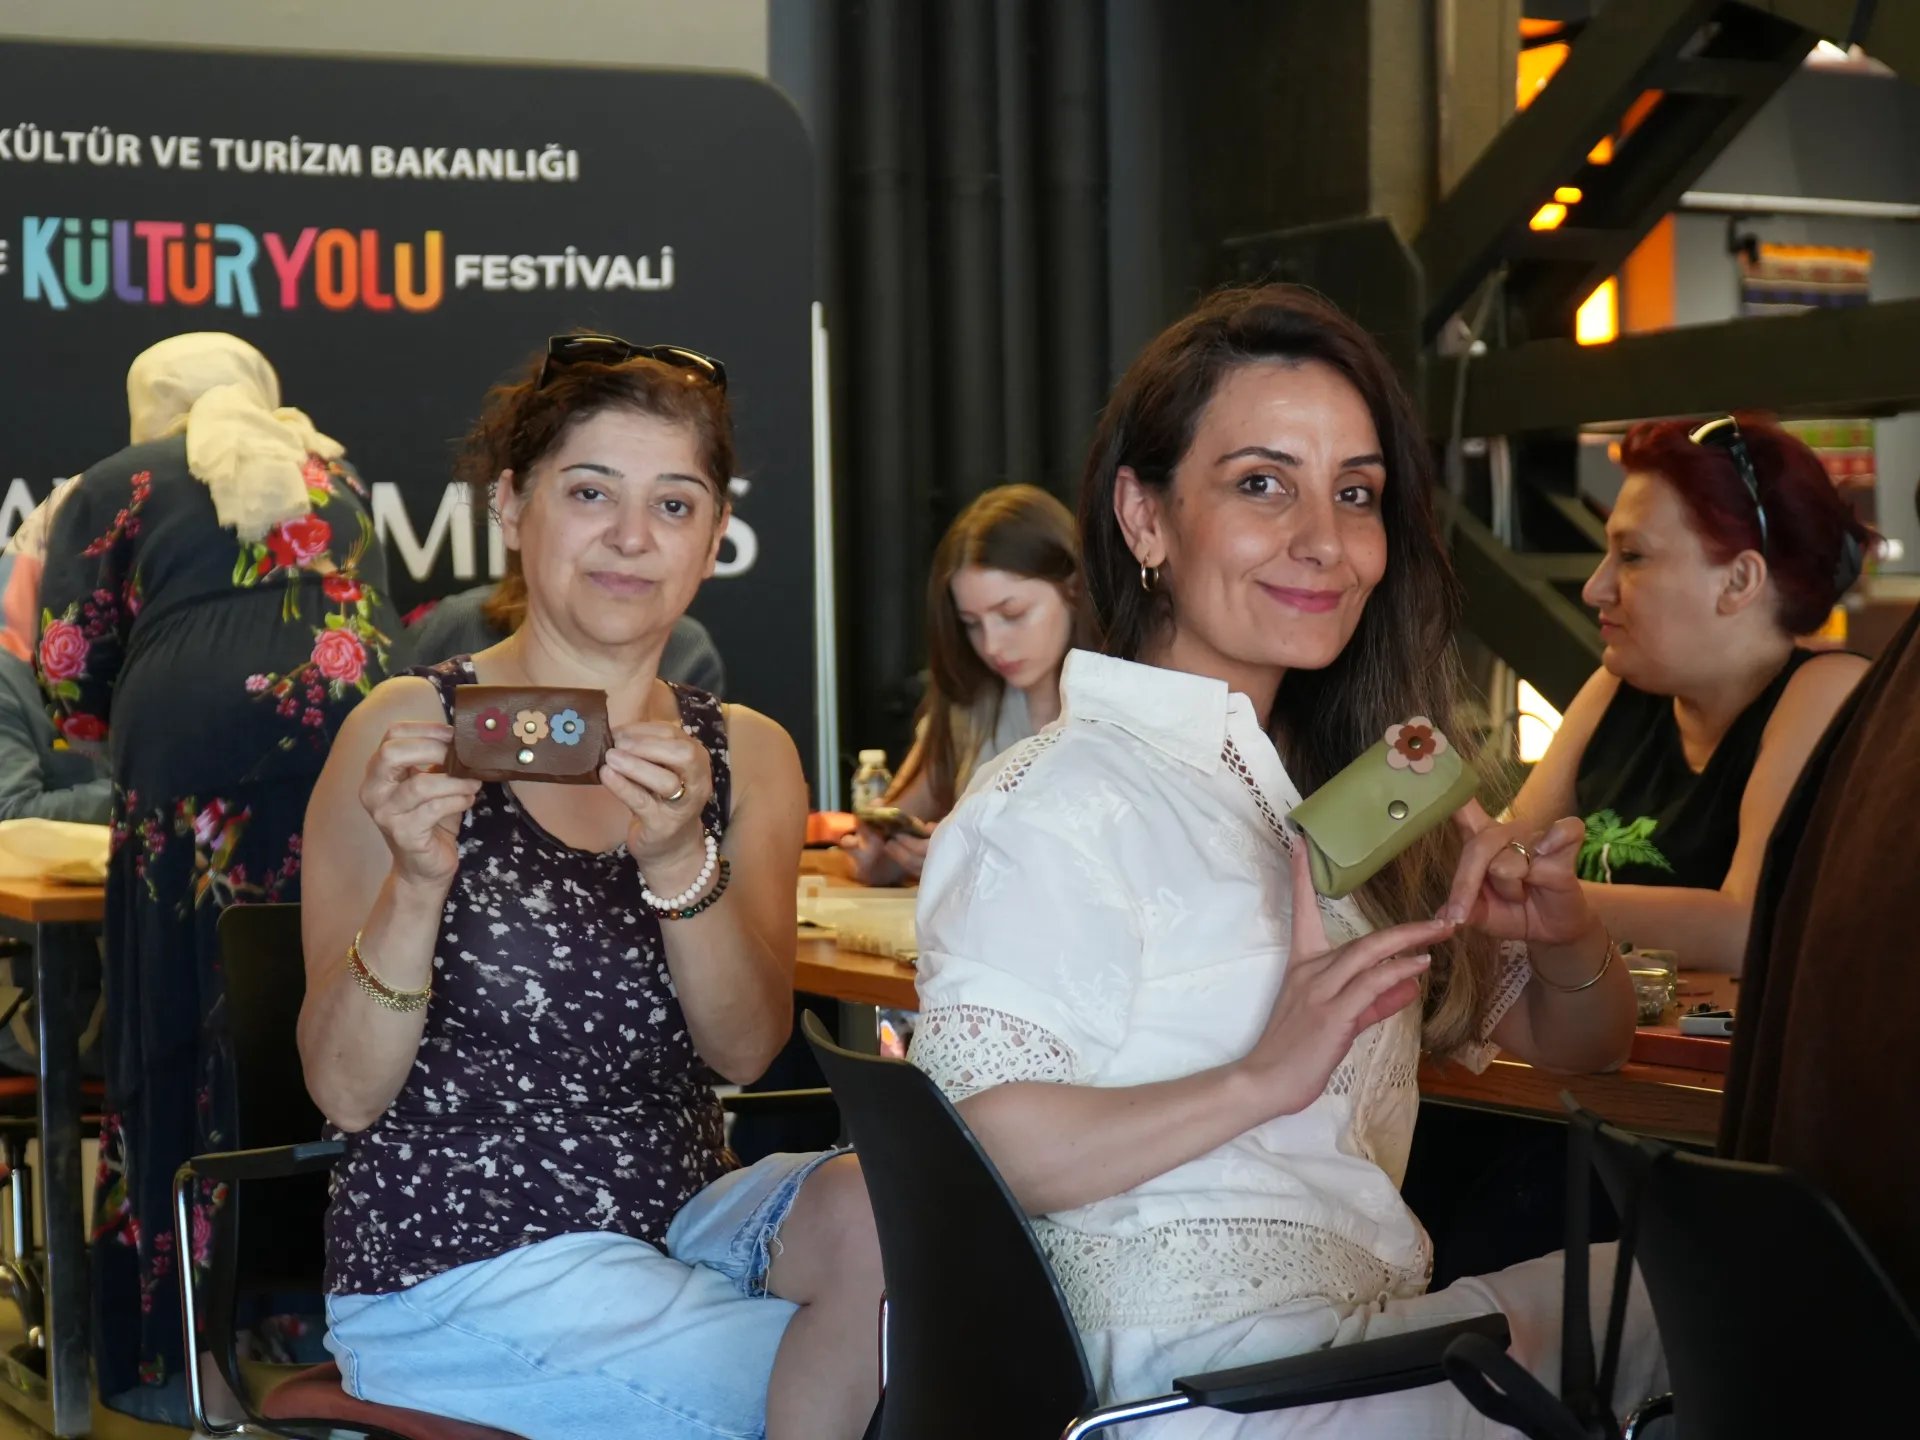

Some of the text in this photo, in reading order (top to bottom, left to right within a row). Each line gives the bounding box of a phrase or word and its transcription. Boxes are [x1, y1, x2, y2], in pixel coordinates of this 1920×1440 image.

[150, 135, 202, 168] VE
[210, 135, 361, 175] TURİZM
[371, 143, 580, 182] BAKANLIĞI
[22, 216, 260, 317] KÜLTÜR
[263, 227, 444, 314] YOLU
[455, 246, 676, 290] FESTİVALİ
